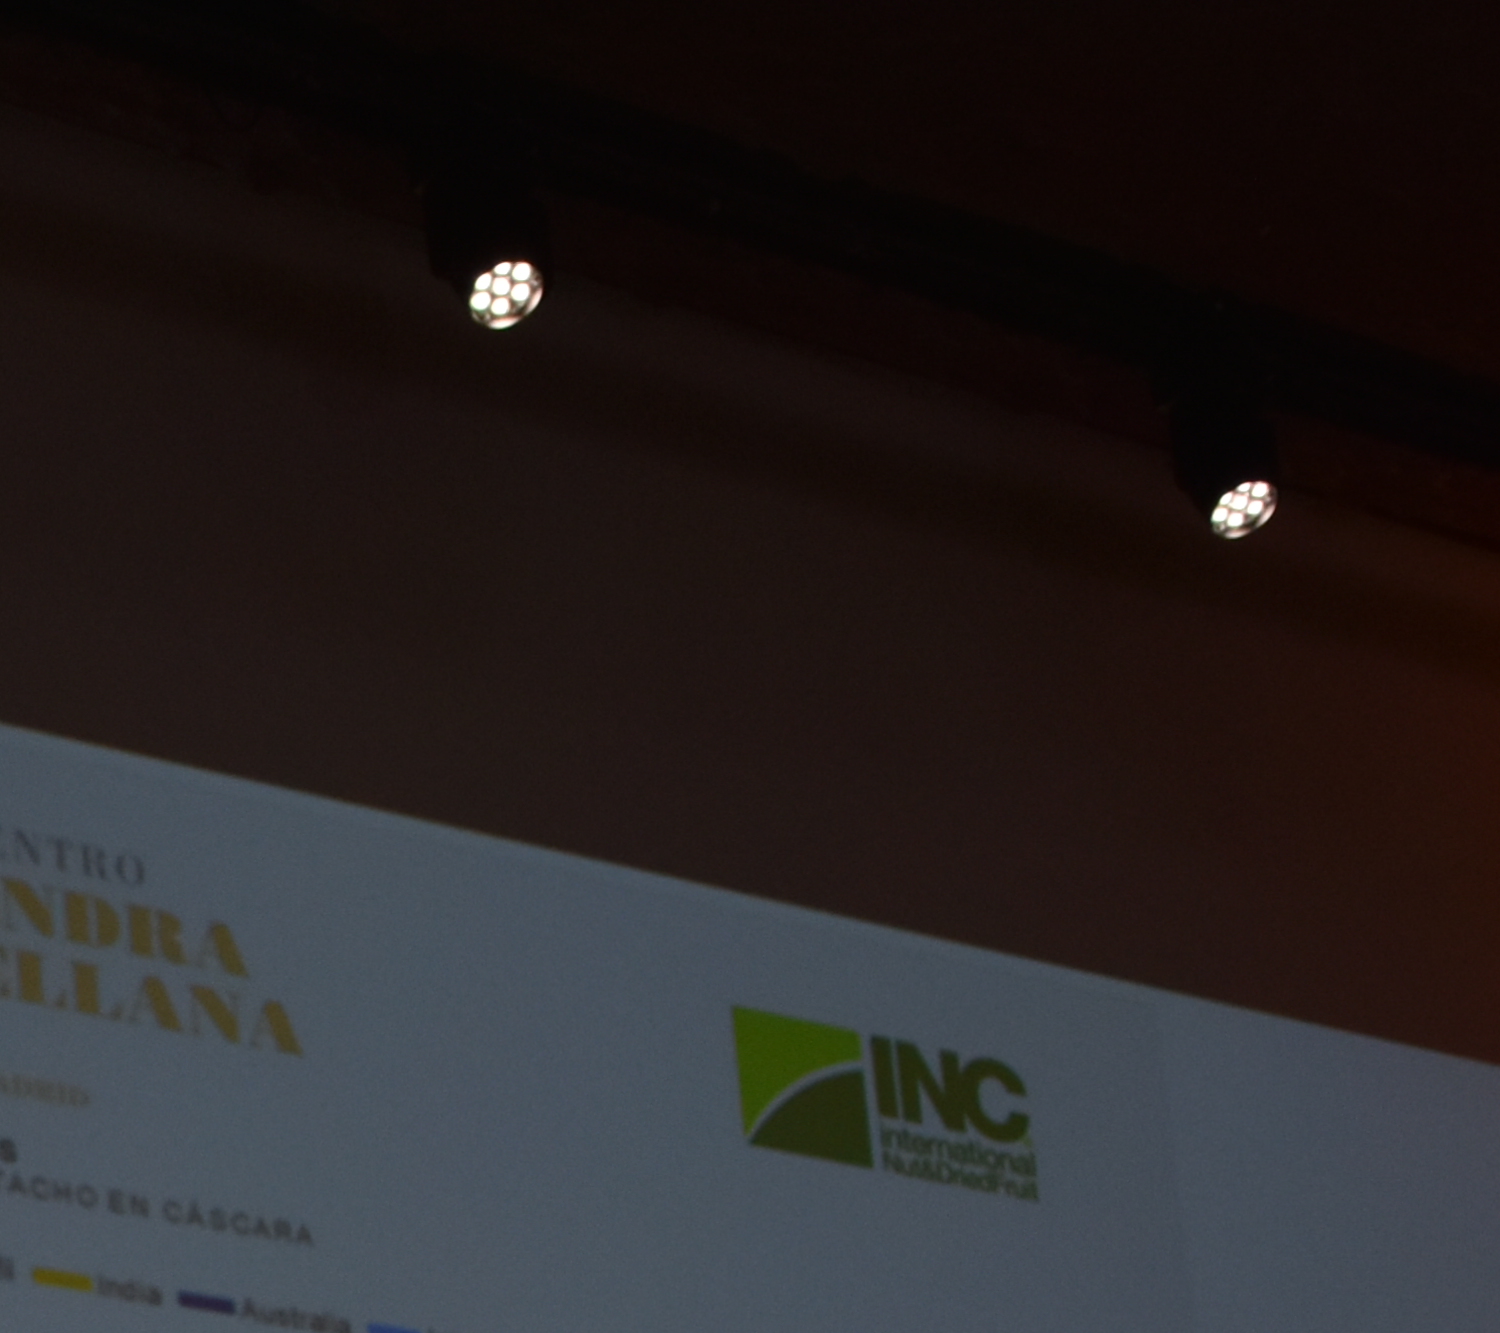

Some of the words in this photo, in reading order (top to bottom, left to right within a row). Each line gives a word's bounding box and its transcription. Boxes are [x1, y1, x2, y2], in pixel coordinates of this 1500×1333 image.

[871, 1034, 1030, 1144] INC
[108, 1191, 149, 1218] EN
[99, 1277, 163, 1305] India
